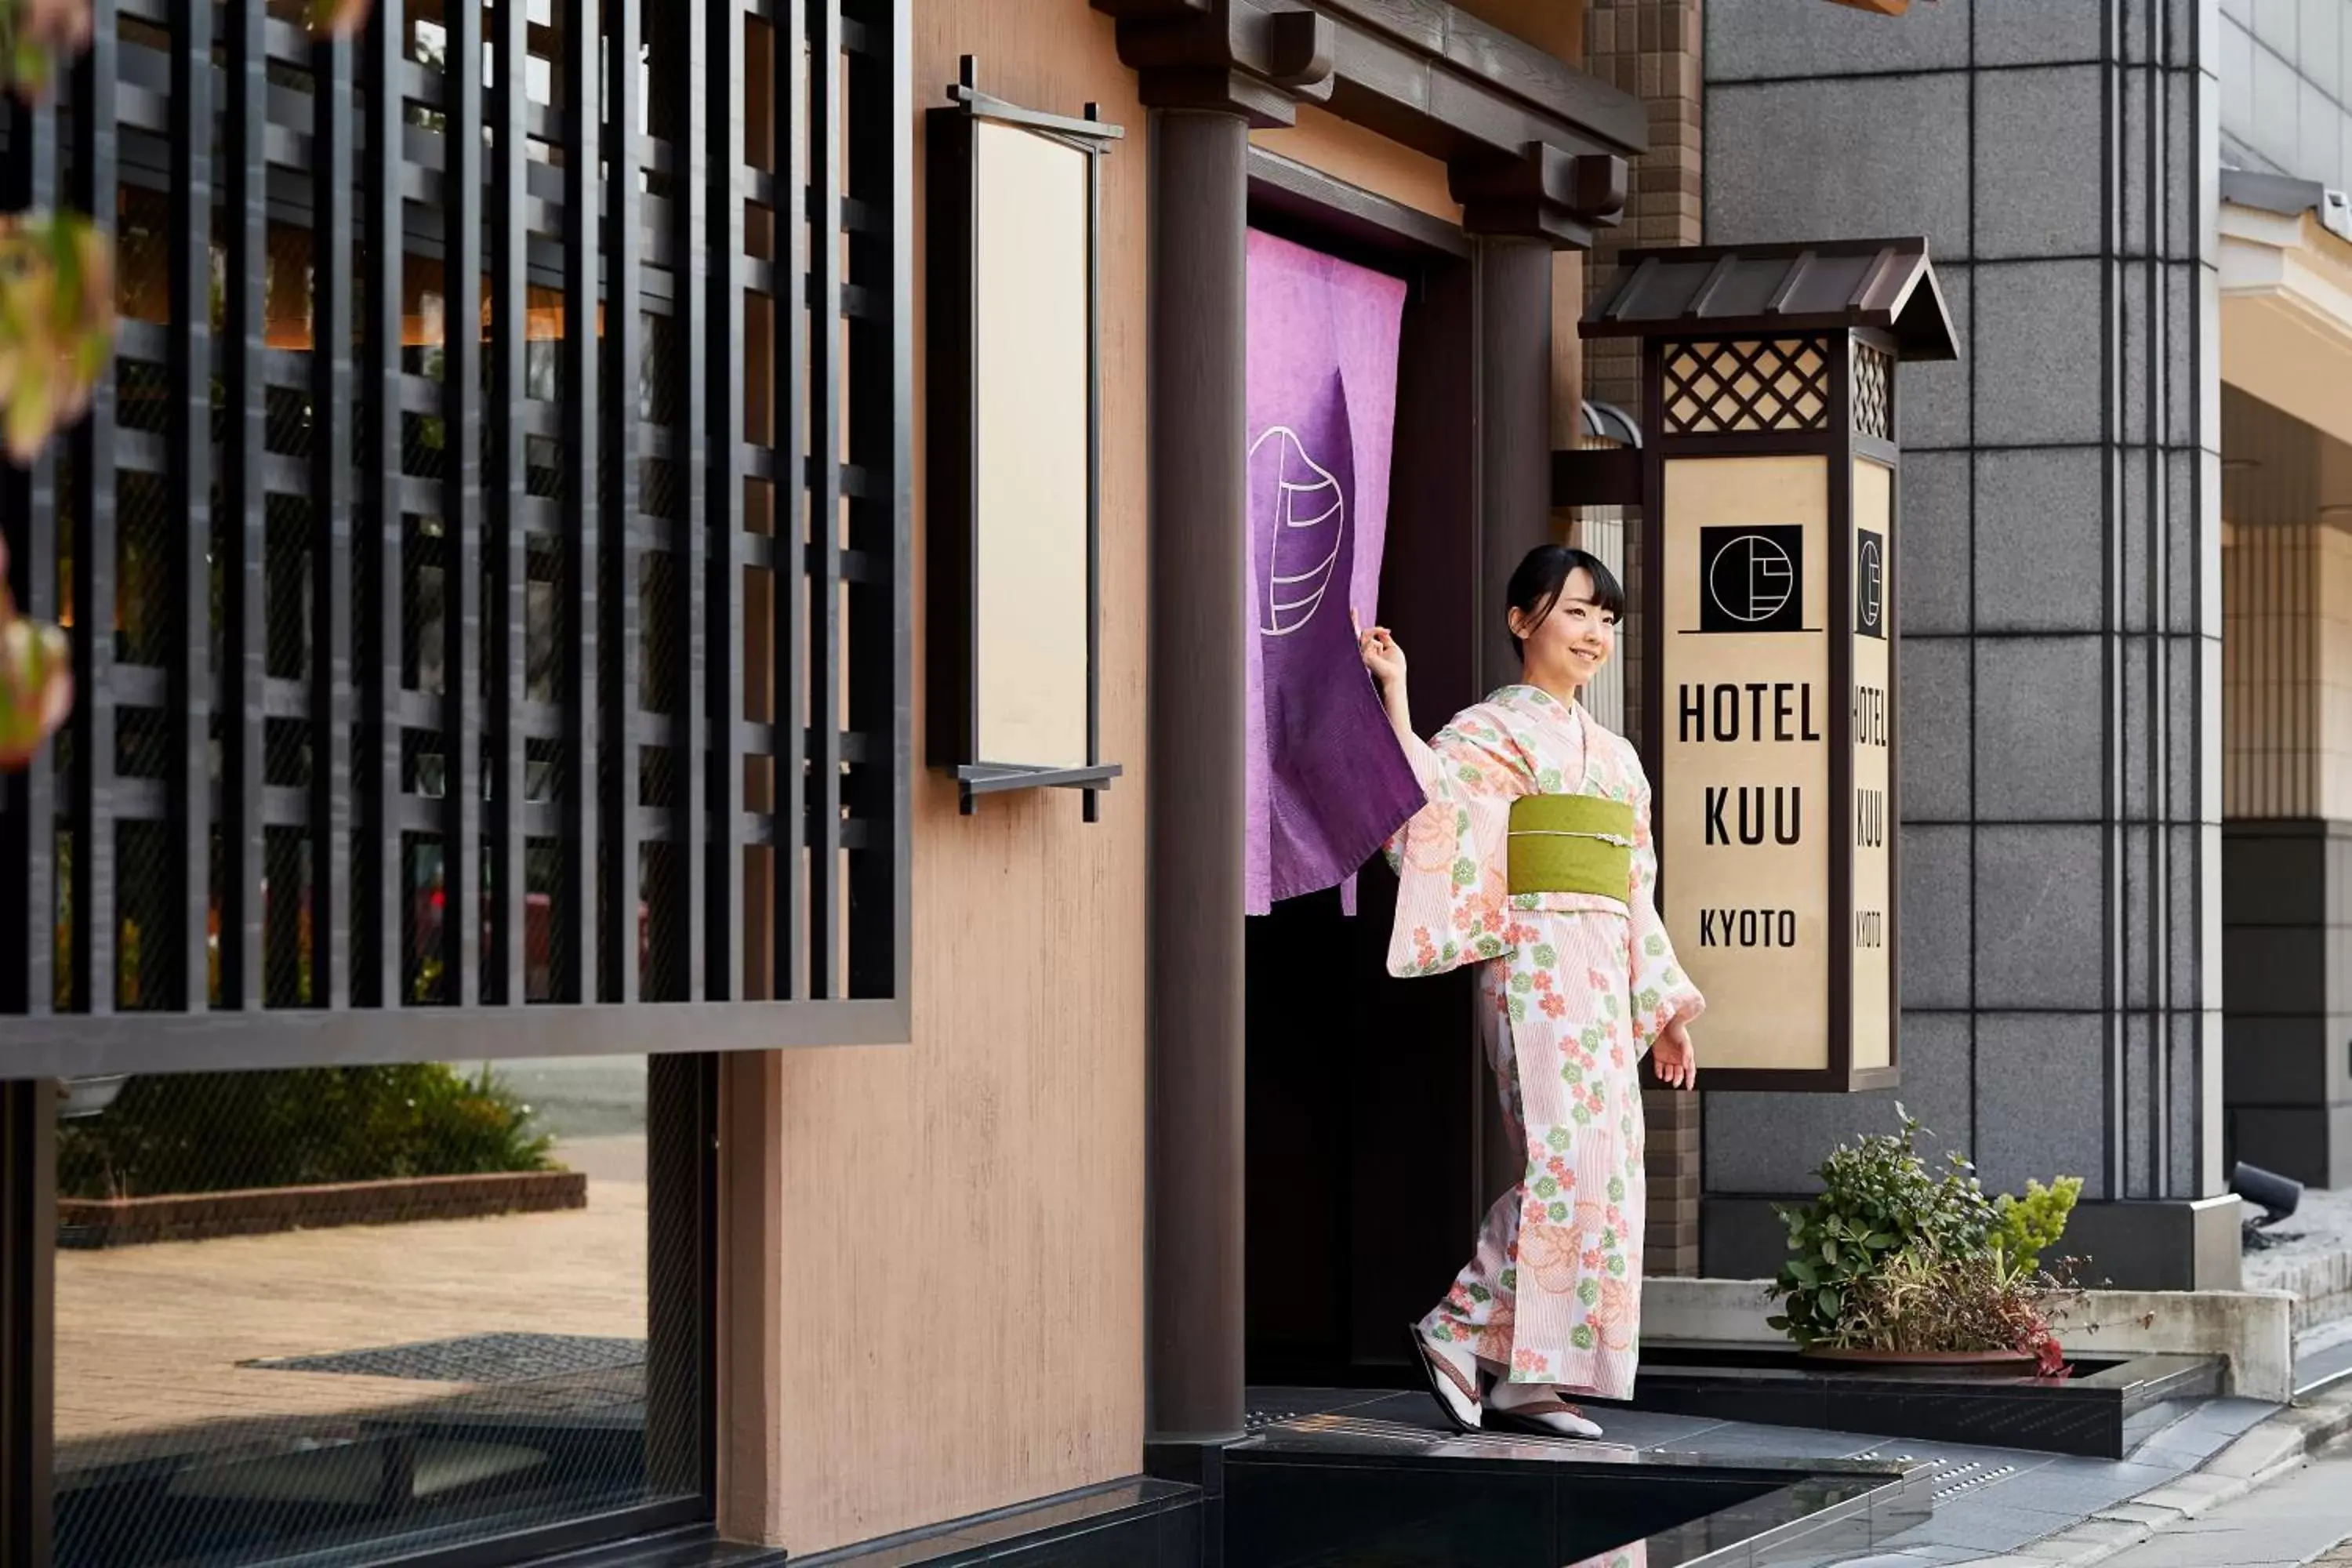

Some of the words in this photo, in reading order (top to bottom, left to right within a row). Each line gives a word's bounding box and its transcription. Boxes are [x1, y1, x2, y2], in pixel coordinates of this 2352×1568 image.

[1679, 683, 1820, 742] HOTEL
[1705, 786, 1801, 846] KUU
[1857, 788, 1882, 848] KUU
[1700, 909, 1795, 947] KYOTO
[1856, 910, 1881, 948] KYOTO
